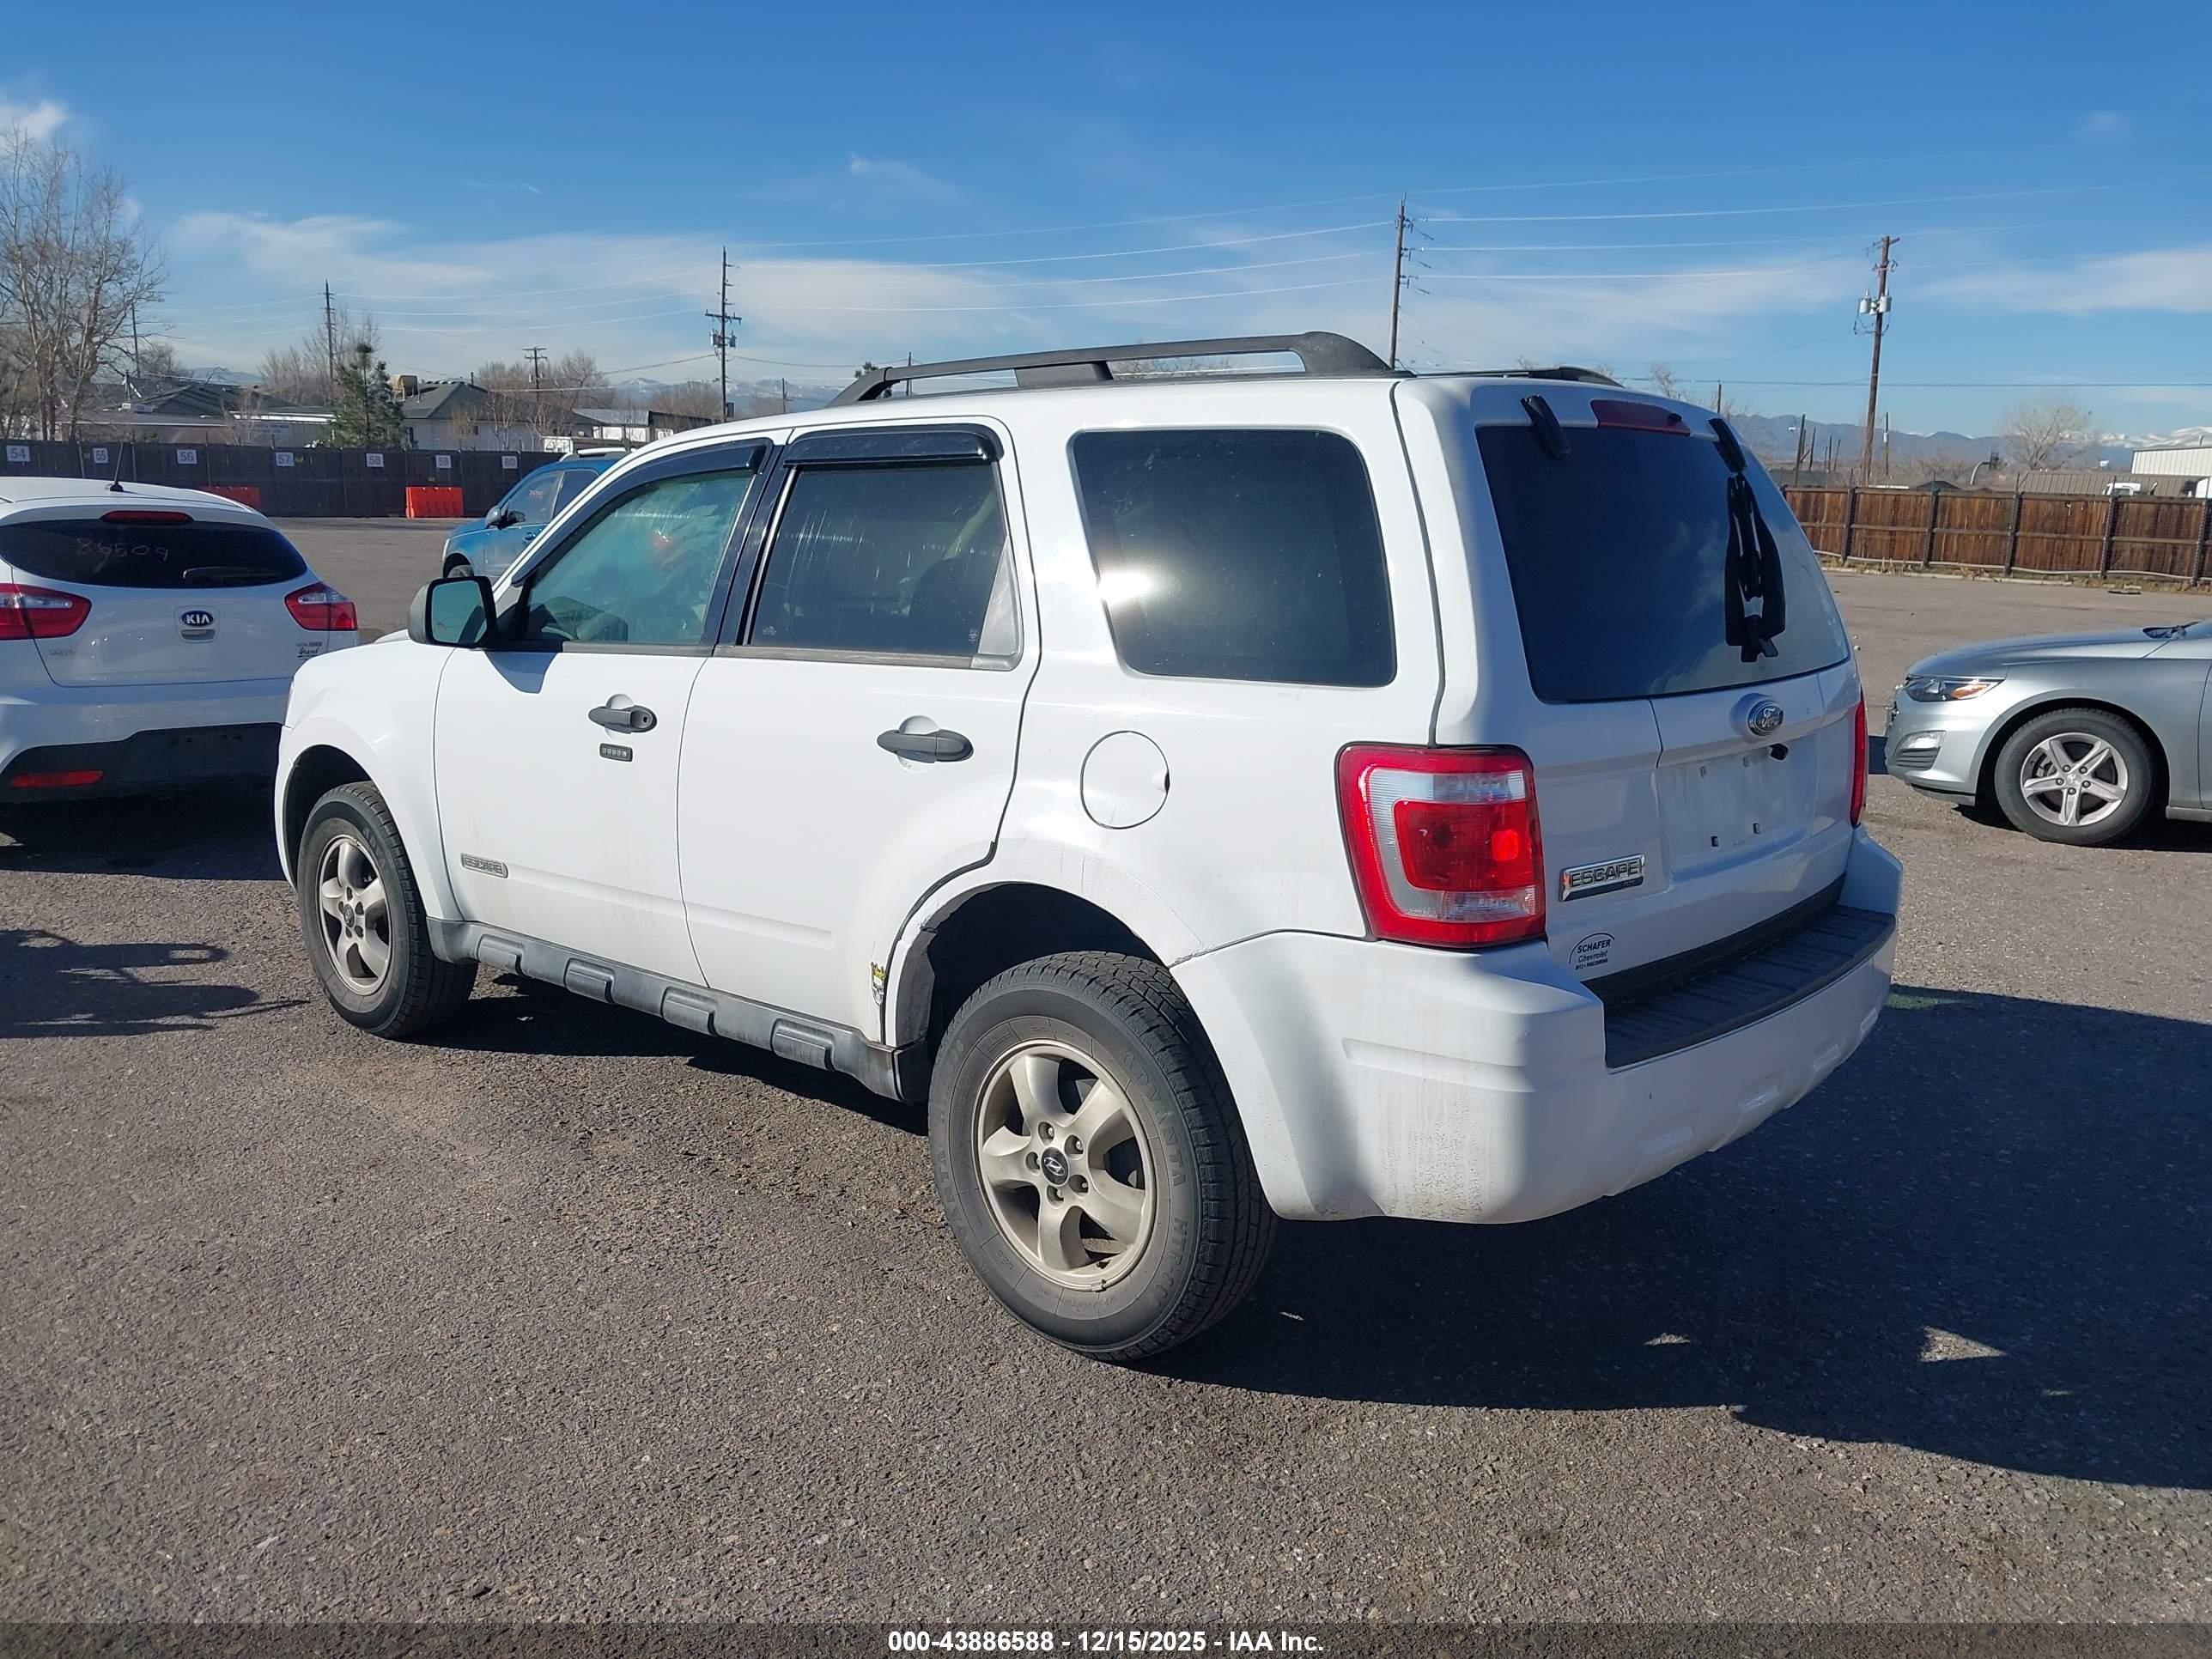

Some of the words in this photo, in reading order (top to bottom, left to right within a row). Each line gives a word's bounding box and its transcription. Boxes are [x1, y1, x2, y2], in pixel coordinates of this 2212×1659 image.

[10, 447, 26, 459] 54
[95, 450, 106, 460] 55
[179, 452, 194, 461] 56
[278, 453, 291, 464] 57
[369, 455, 381, 465] 58
[186, 614, 210, 624] KIA
[1571, 861, 1639, 887] ESCAPE
[1577, 939, 1611, 954] SCHAFER
[1578, 950, 1607, 963] Chevrolet
